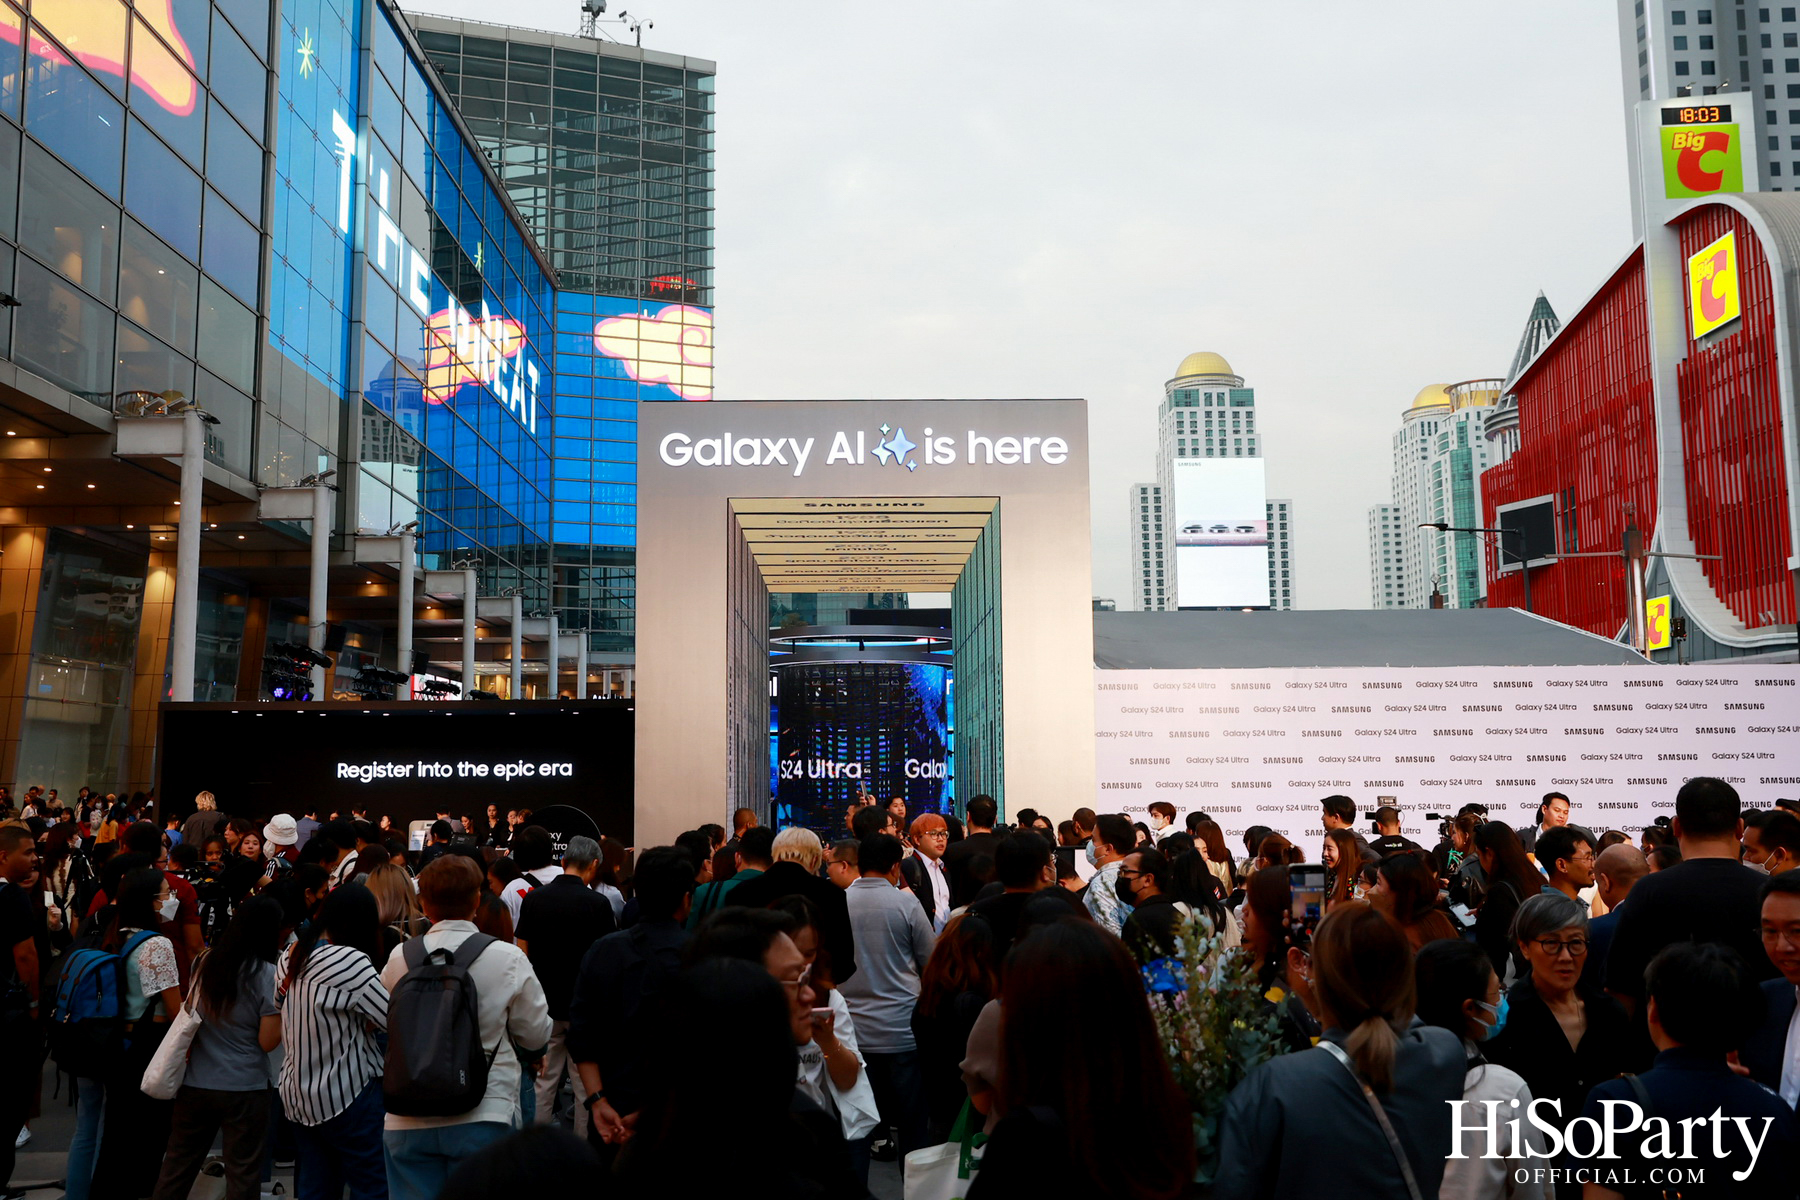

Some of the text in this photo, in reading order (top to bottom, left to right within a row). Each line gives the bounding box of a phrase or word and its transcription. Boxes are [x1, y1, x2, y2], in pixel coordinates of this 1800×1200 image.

[1679, 107, 1720, 124] 18:03
[1672, 131, 1730, 192] Big C
[1696, 249, 1728, 322] Big C
[659, 427, 1068, 477] Galaxy AI is here
[1153, 683, 1181, 691] Galaxy
[1285, 682, 1313, 691] Galaxy
[1416, 681, 1444, 690] Galaxy
[1546, 680, 1574, 689] Galaxy
[1623, 680, 1664, 688] SAMSUNG
[1676, 679, 1704, 688] Galaxy
[1121, 706, 1149, 715] Galaxy
[1253, 706, 1281, 715] Galaxy
[1384, 705, 1412, 714] Galaxy
[1515, 704, 1543, 713] Galaxy
[1645, 703, 1673, 712] Galaxy
[1223, 730, 1251, 739] Galaxy
[1354, 729, 1382, 738] Galaxy
[1485, 728, 1513, 737] Galaxy
[1616, 727, 1644, 736] Galaxy
[1747, 726, 1776, 735] Galaxy
[1094, 731, 1118, 740] alaxy
[1318, 756, 1346, 765] Galaxy
[1450, 754, 1512, 764] Galaxy S24 Ultra
[1526, 754, 1567, 762] SAMSUNG
[1580, 753, 1643, 763] Galaxy S24 Ultra
[1657, 753, 1698, 761] SAMSUNG
[1712, 752, 1775, 761] Galaxy S24 Ultra
[1186, 757, 1214, 766] Galaxy
[337, 760, 572, 783] Register into the epic era
[780, 758, 862, 779] S24 Ultra
[1155, 781, 1184, 790] Galaxy
[1231, 781, 1272, 789] SAMSUNG
[1288, 780, 1316, 789] Galaxy
[1364, 780, 1404, 788] SAMSUNG
[1420, 779, 1448, 788] Galaxy
[1551, 778, 1579, 787] Galaxy
[1256, 805, 1284, 813] Galaxy
[1598, 802, 1638, 810] SAMSUNG
